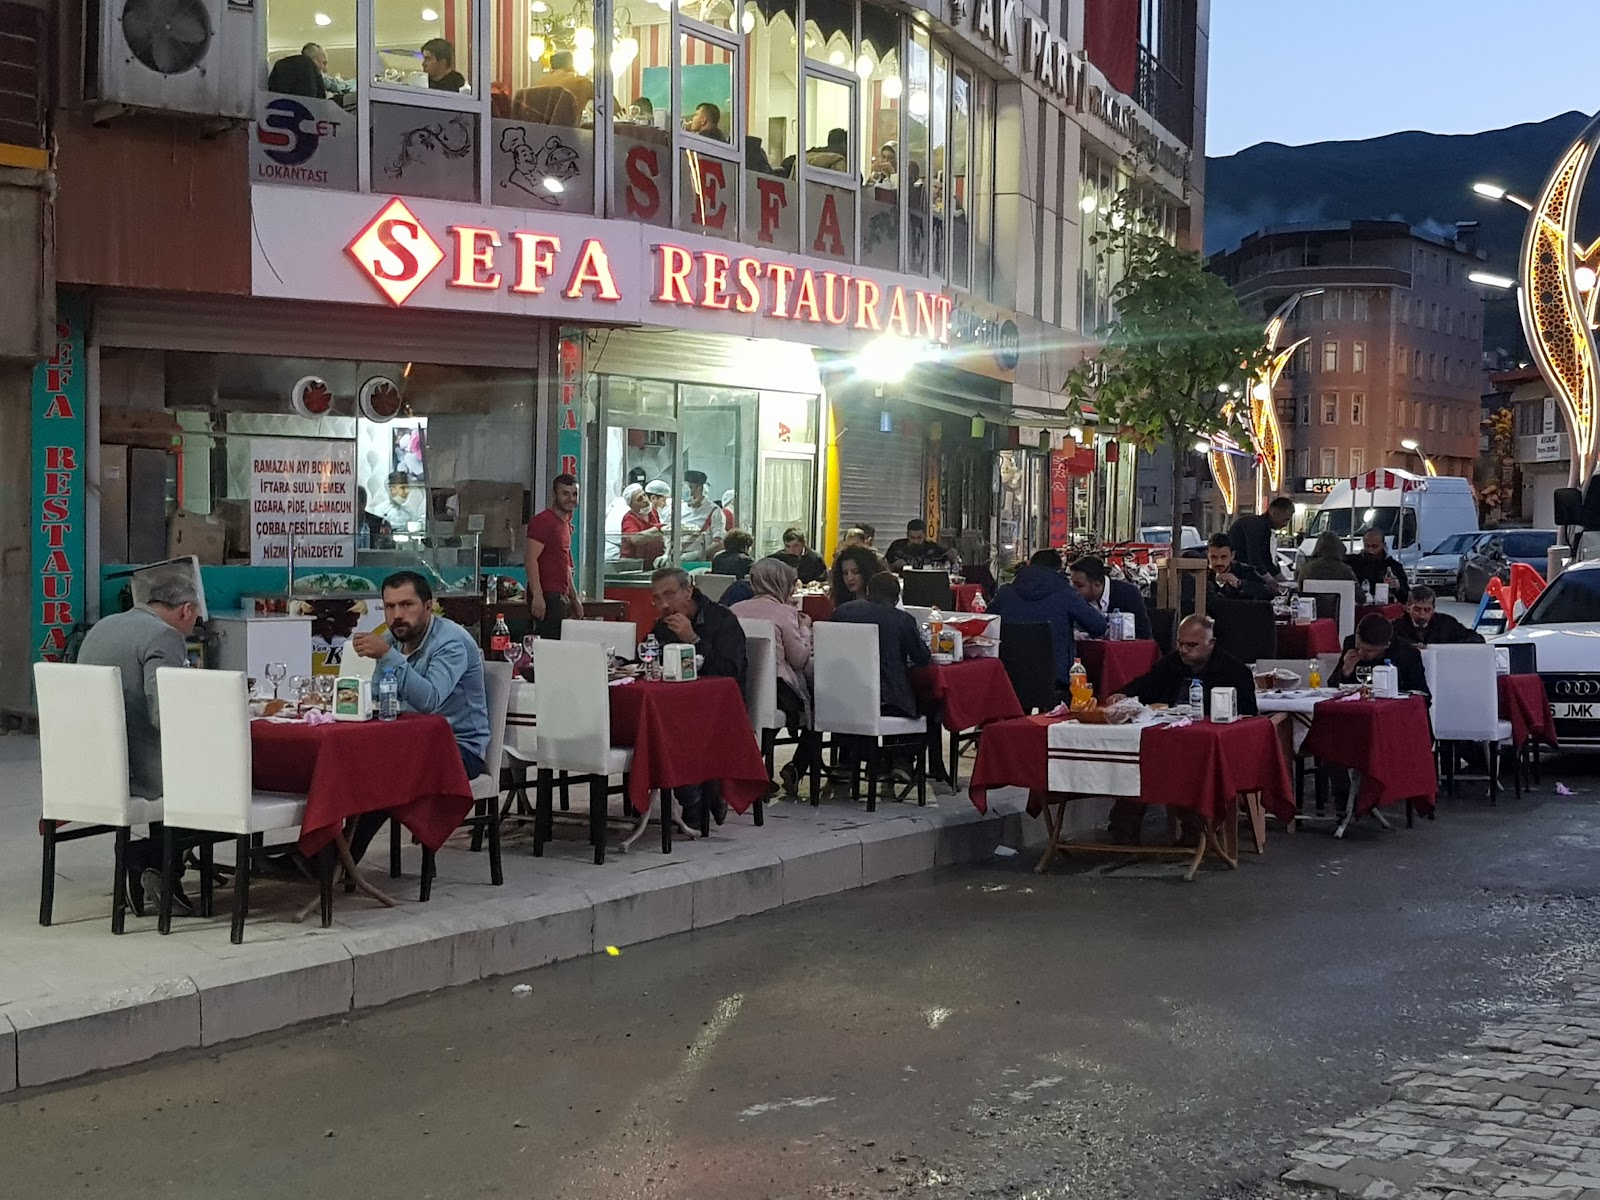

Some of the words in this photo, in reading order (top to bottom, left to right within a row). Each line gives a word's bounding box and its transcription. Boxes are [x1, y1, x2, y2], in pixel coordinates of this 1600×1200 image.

[625, 145, 845, 256] SEFA
[373, 219, 622, 300] SEFA
[657, 244, 952, 345] RESTAURANT
[254, 459, 294, 474] RAMAZAN
[296, 460, 310, 474] AYI
[312, 460, 351, 475] BOYUNCA
[260, 478, 290, 494] İFTARA
[293, 481, 314, 494] SULU
[317, 481, 346, 494] YEMEK
[309, 500, 352, 513] LAHMACUN
[256, 521, 286, 539] ÇORBA
[1563, 703, 1593, 718] JMK
